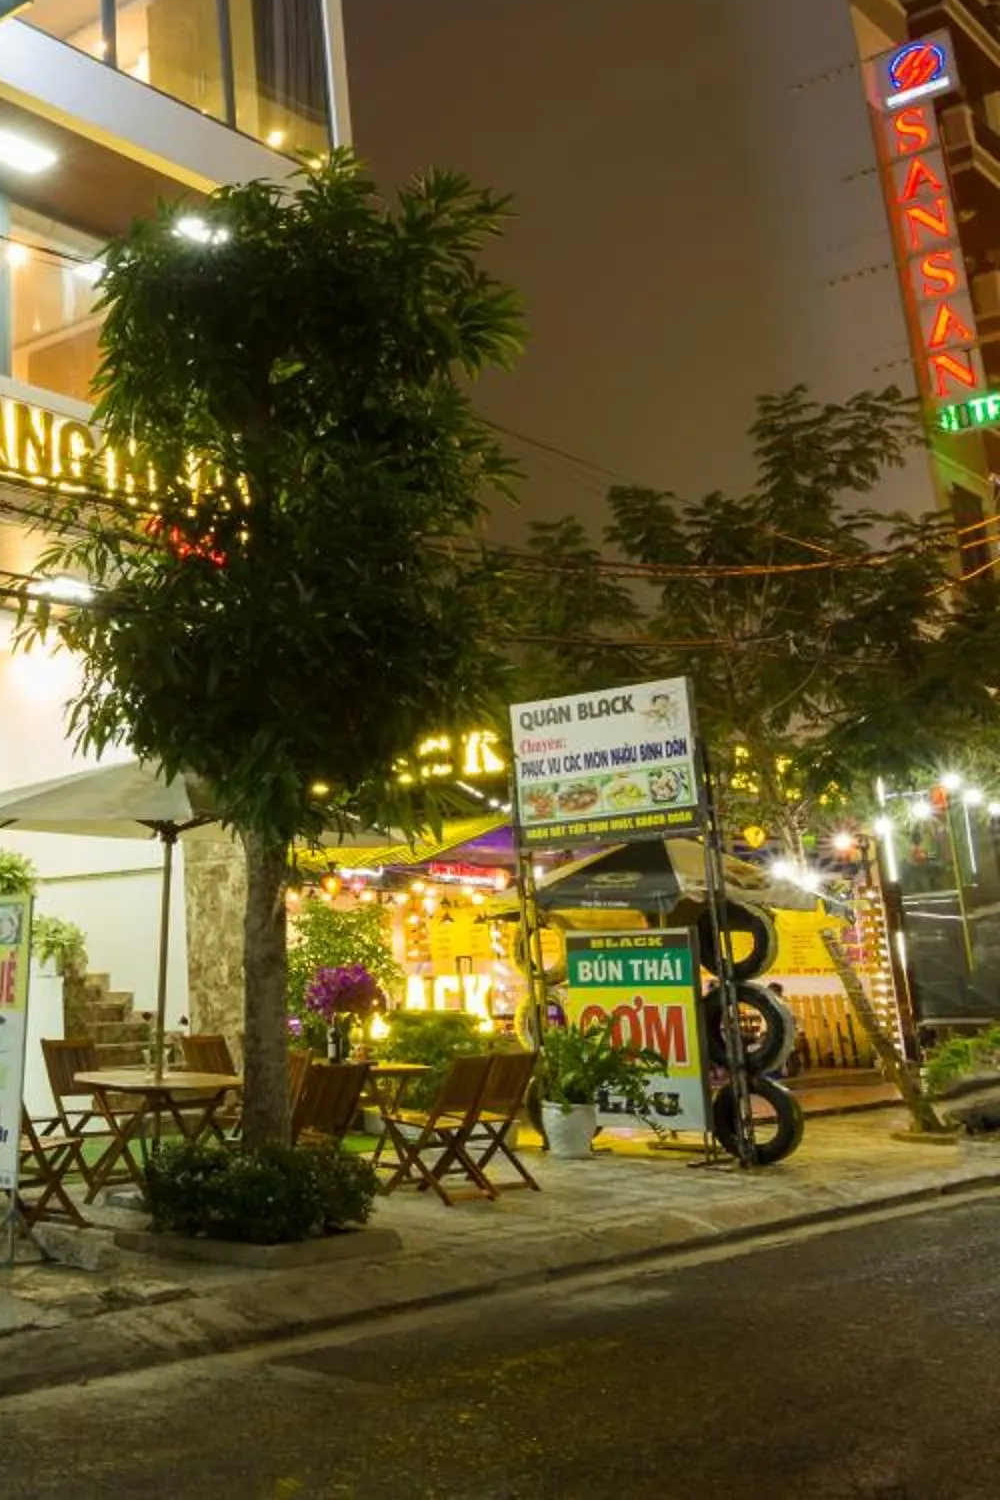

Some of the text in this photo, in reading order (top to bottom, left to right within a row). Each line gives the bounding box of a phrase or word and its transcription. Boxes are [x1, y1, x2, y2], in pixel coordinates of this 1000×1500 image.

[519, 694, 636, 731] QUÁN BLACK
[590, 936, 664, 949] BLACK
[577, 952, 683, 982] BÚN THÁI
